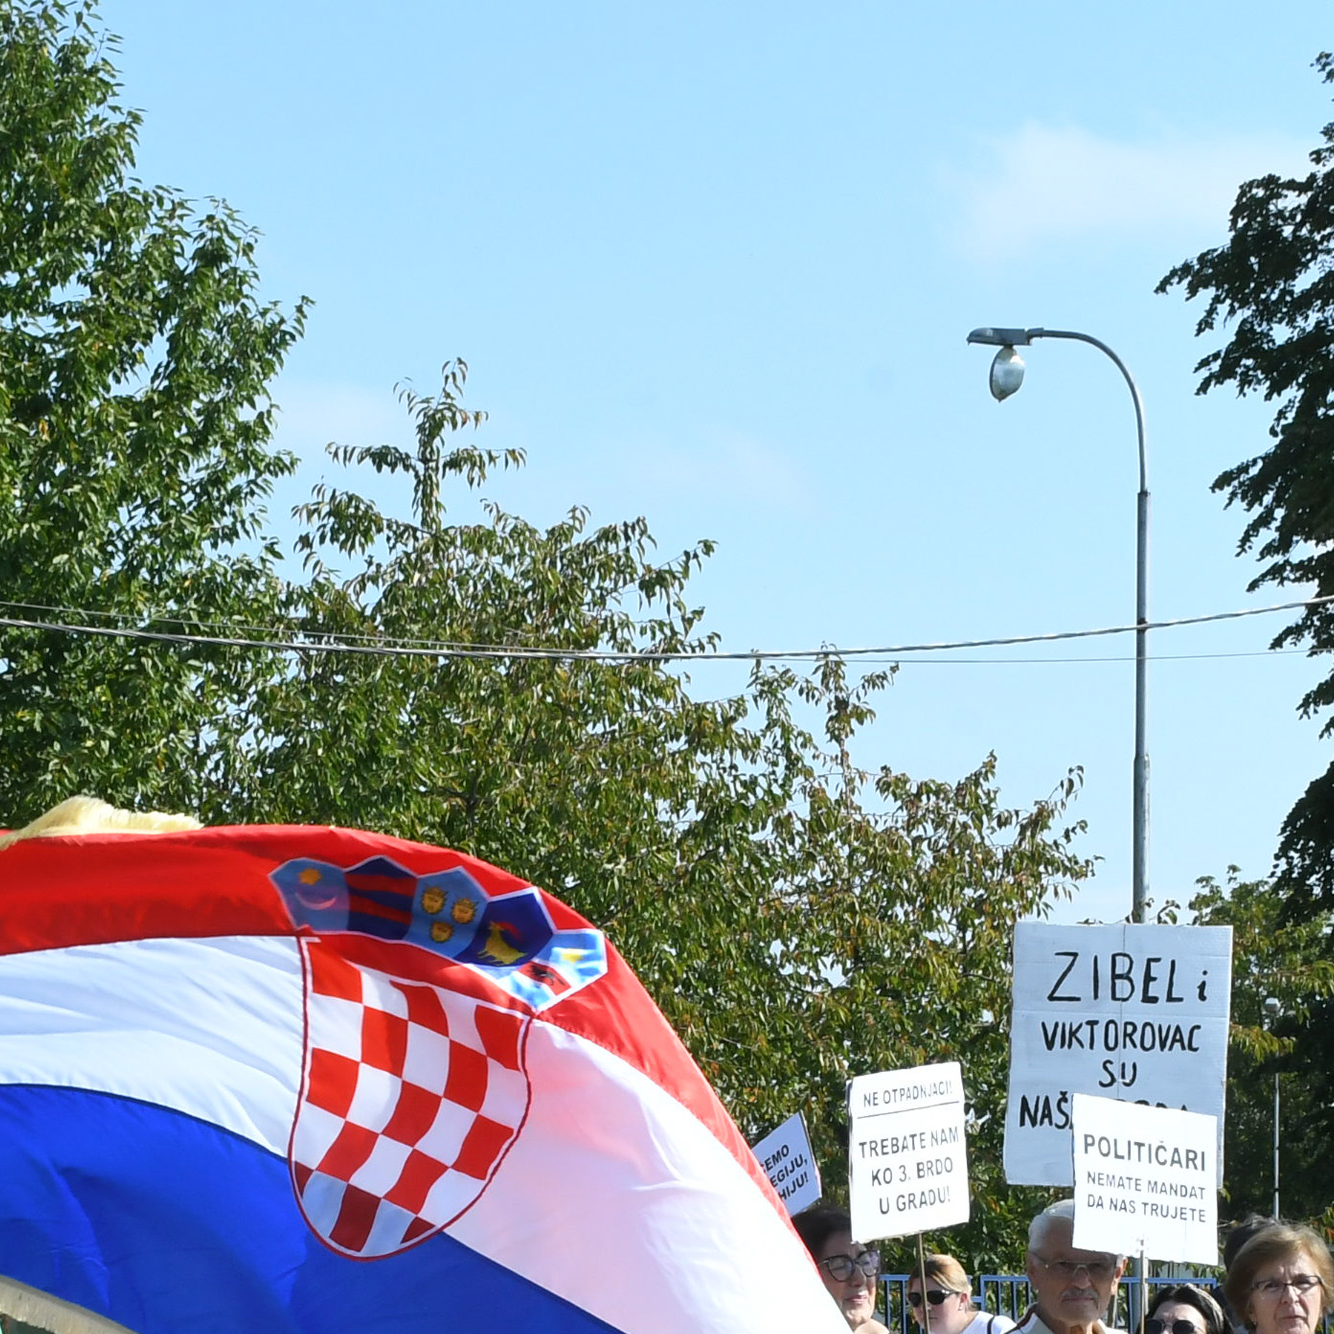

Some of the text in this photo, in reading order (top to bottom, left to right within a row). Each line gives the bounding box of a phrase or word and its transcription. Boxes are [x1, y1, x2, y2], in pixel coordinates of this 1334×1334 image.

[1047, 951, 1184, 1004] ZIBEL
[1042, 1018, 1201, 1052] VIKTOROVAC
[1099, 1059, 1137, 1088] SU
[864, 1091, 879, 1108] NE
[1019, 1089, 1071, 1130] NAŠ
[859, 1126, 959, 1159] TREBATE NAM
[1083, 1134, 1206, 1173] POLITIČARI
[770, 1154, 808, 1188] EGIJU,
[778, 1172, 809, 1200] HIJU!
[871, 1157, 954, 1187] KO 3. BRDO
[1087, 1171, 1206, 1200] NEMATE MANDAT
[879, 1186, 951, 1215] U GRADU!
[1087, 1194, 1206, 1224] DA NAS TRUJETE
